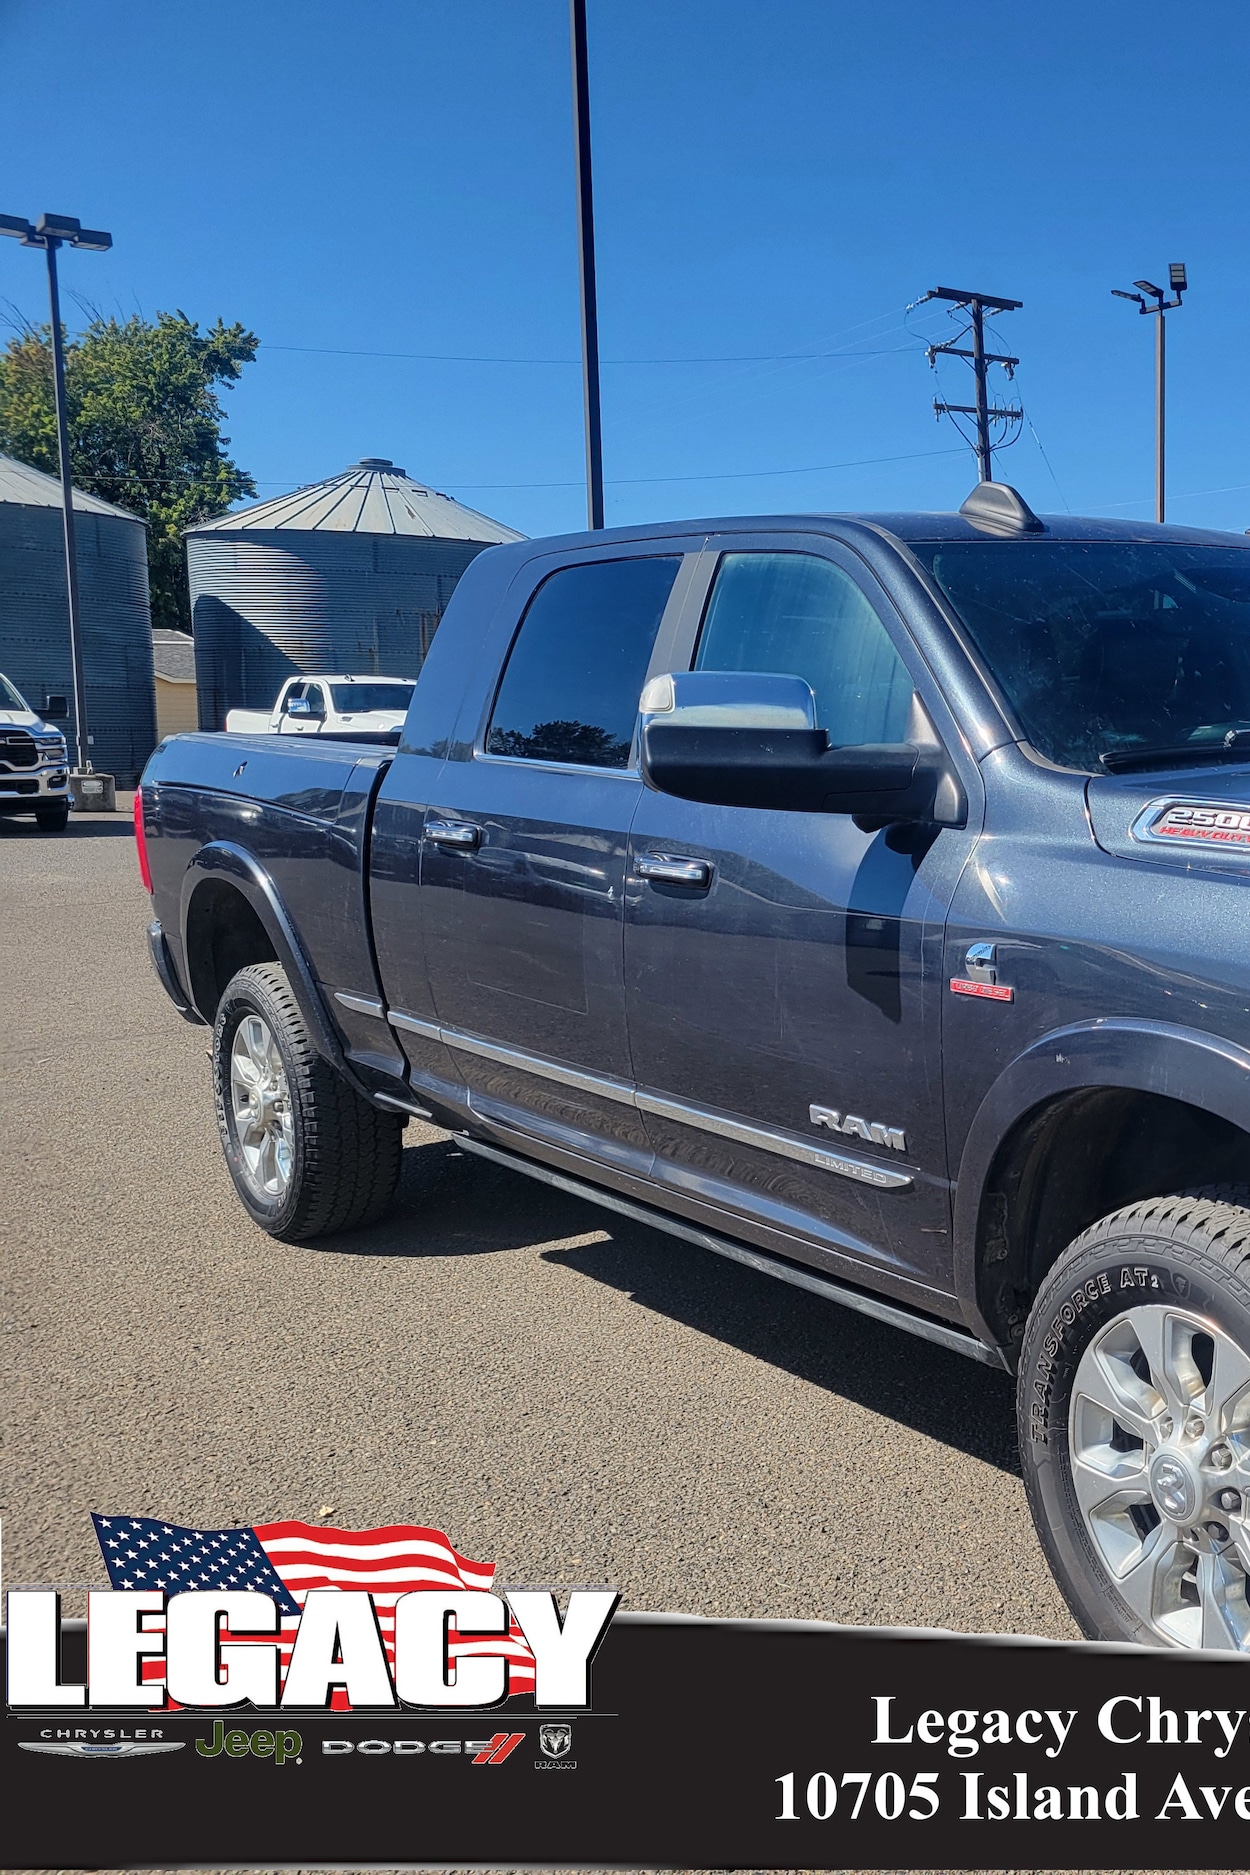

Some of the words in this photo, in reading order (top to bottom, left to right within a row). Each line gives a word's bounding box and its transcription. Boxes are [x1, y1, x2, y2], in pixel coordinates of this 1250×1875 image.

[1159, 826, 1210, 839] HEAVY
[809, 1103, 906, 1151] RAM
[814, 1153, 887, 1184] LIMITED
[1030, 1273, 1112, 1445] TRANSFORCE
